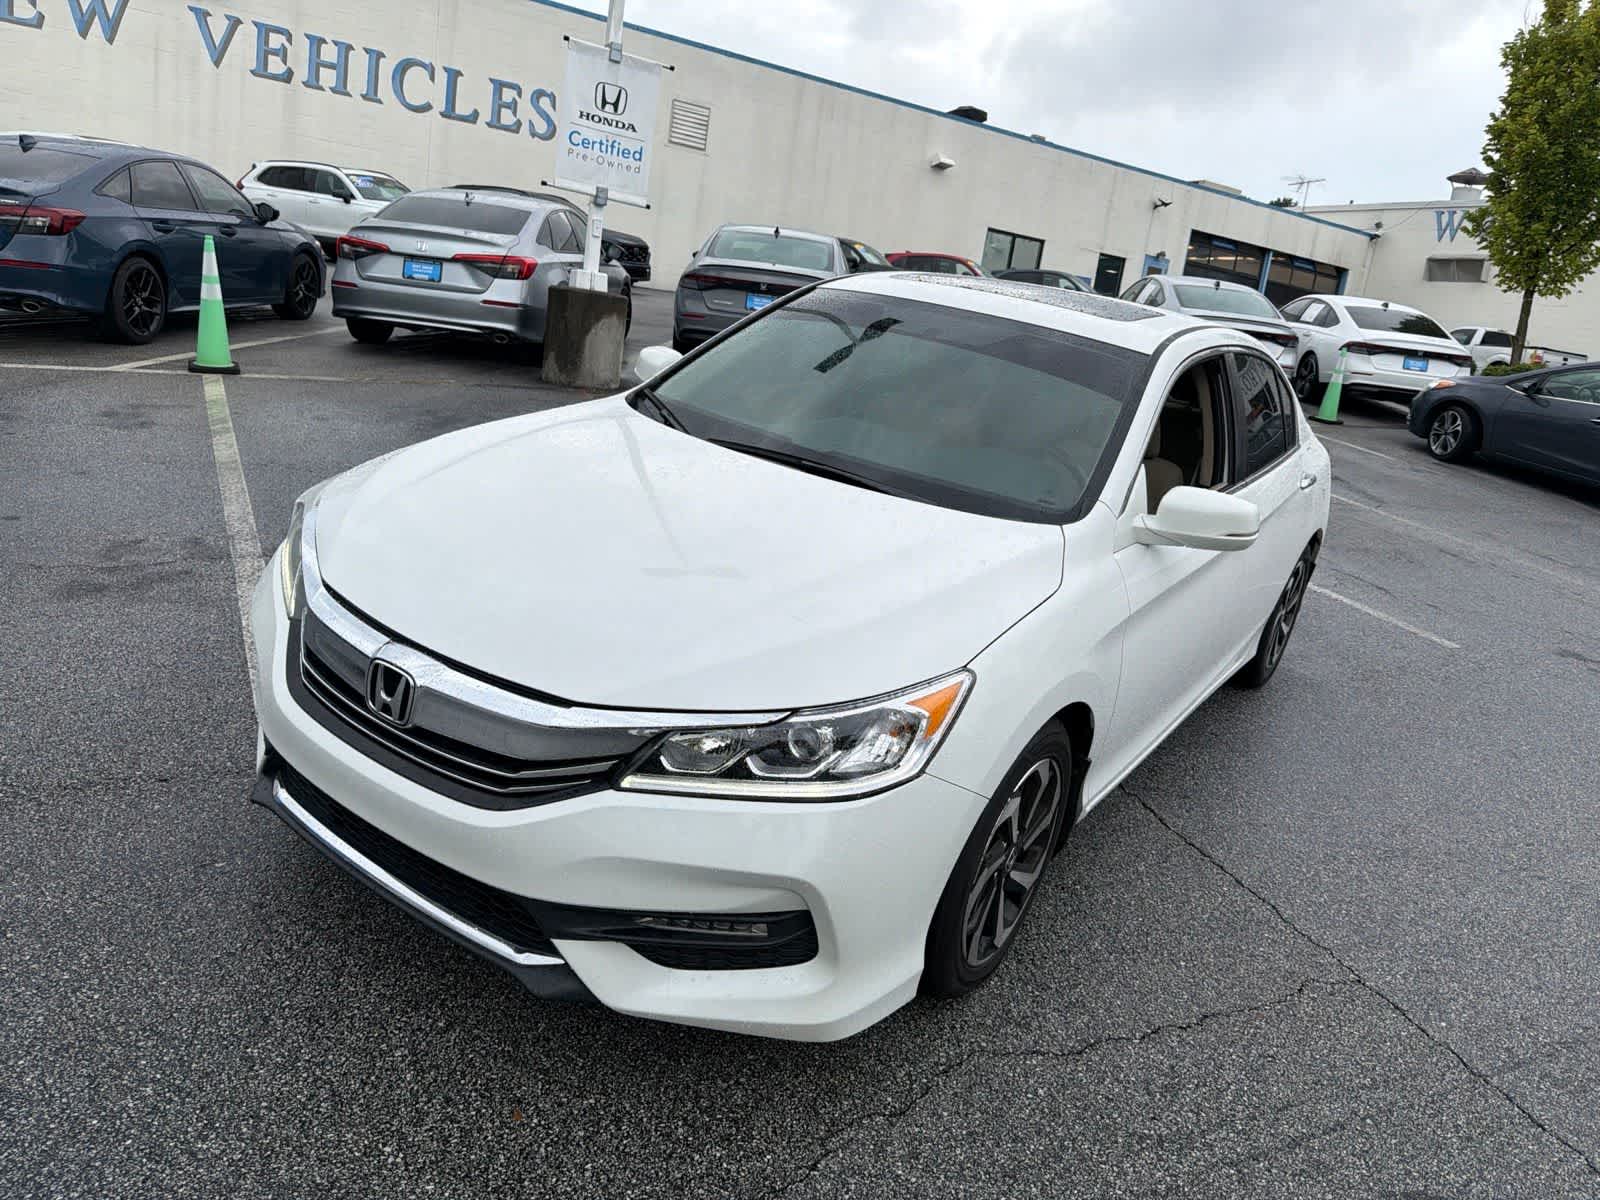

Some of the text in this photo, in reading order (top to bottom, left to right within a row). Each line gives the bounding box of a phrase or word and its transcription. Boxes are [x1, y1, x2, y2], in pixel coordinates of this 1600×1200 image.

[187, 5, 557, 141] VEHICLES
[578, 110, 638, 133] HONDA
[568, 130, 643, 162] Certified
[568, 149, 641, 174] Pre-Owned
